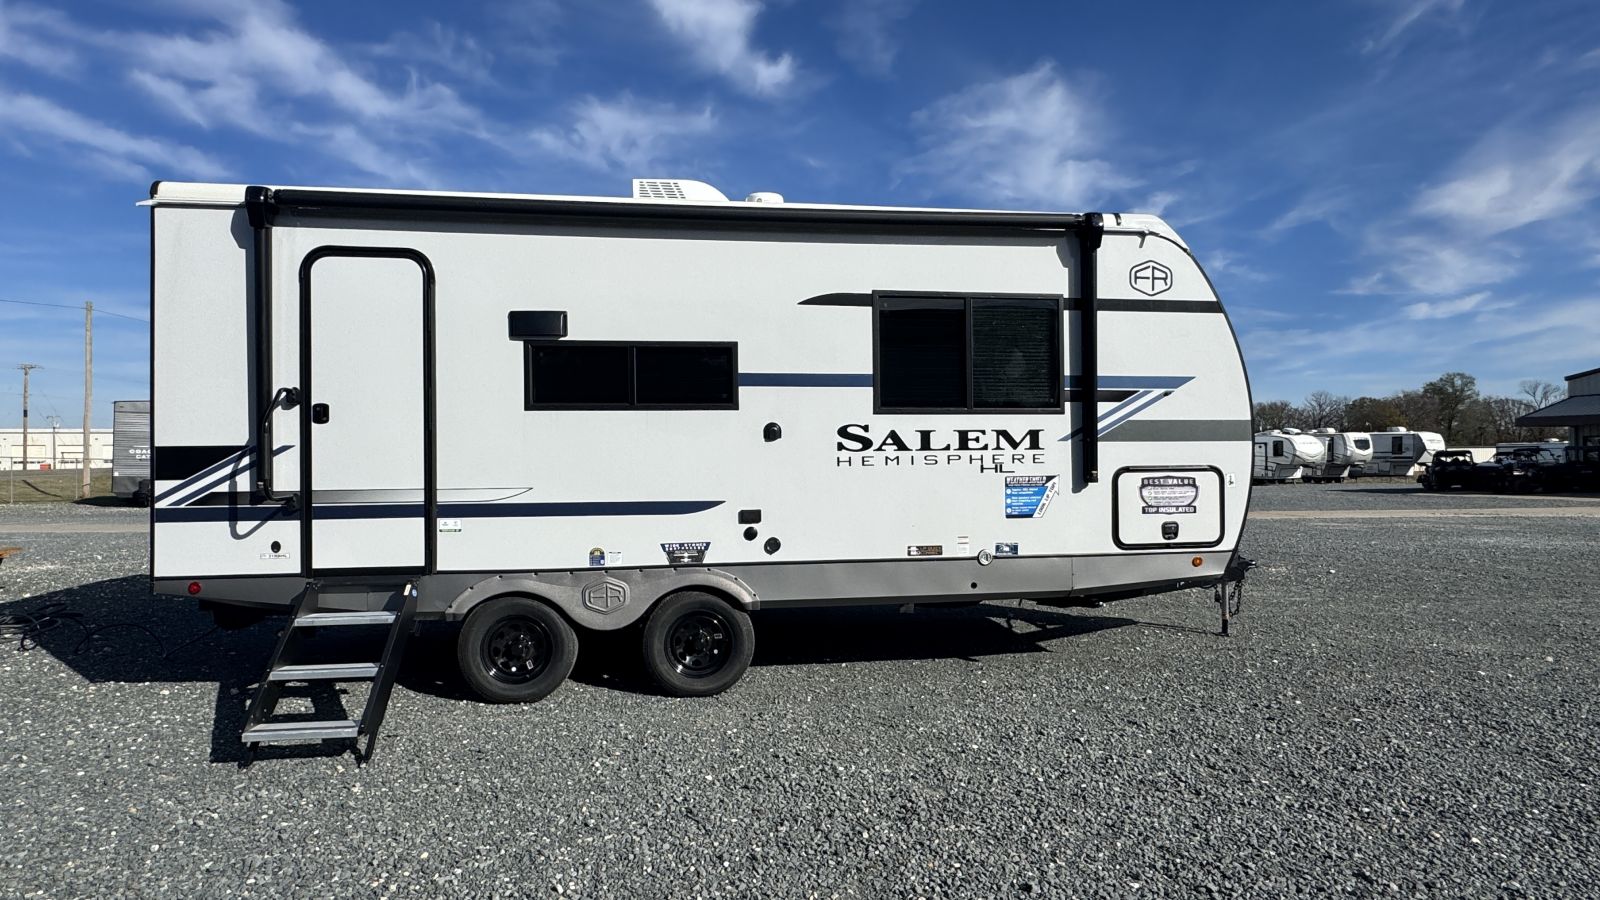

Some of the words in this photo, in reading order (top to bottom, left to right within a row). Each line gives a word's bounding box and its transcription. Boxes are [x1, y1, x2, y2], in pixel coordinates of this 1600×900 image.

[1134, 265, 1168, 291] FR
[837, 424, 1045, 452] SALEM
[836, 454, 1045, 467] HEMISPHERE
[980, 464, 1015, 473] HL
[589, 583, 623, 608] FR
